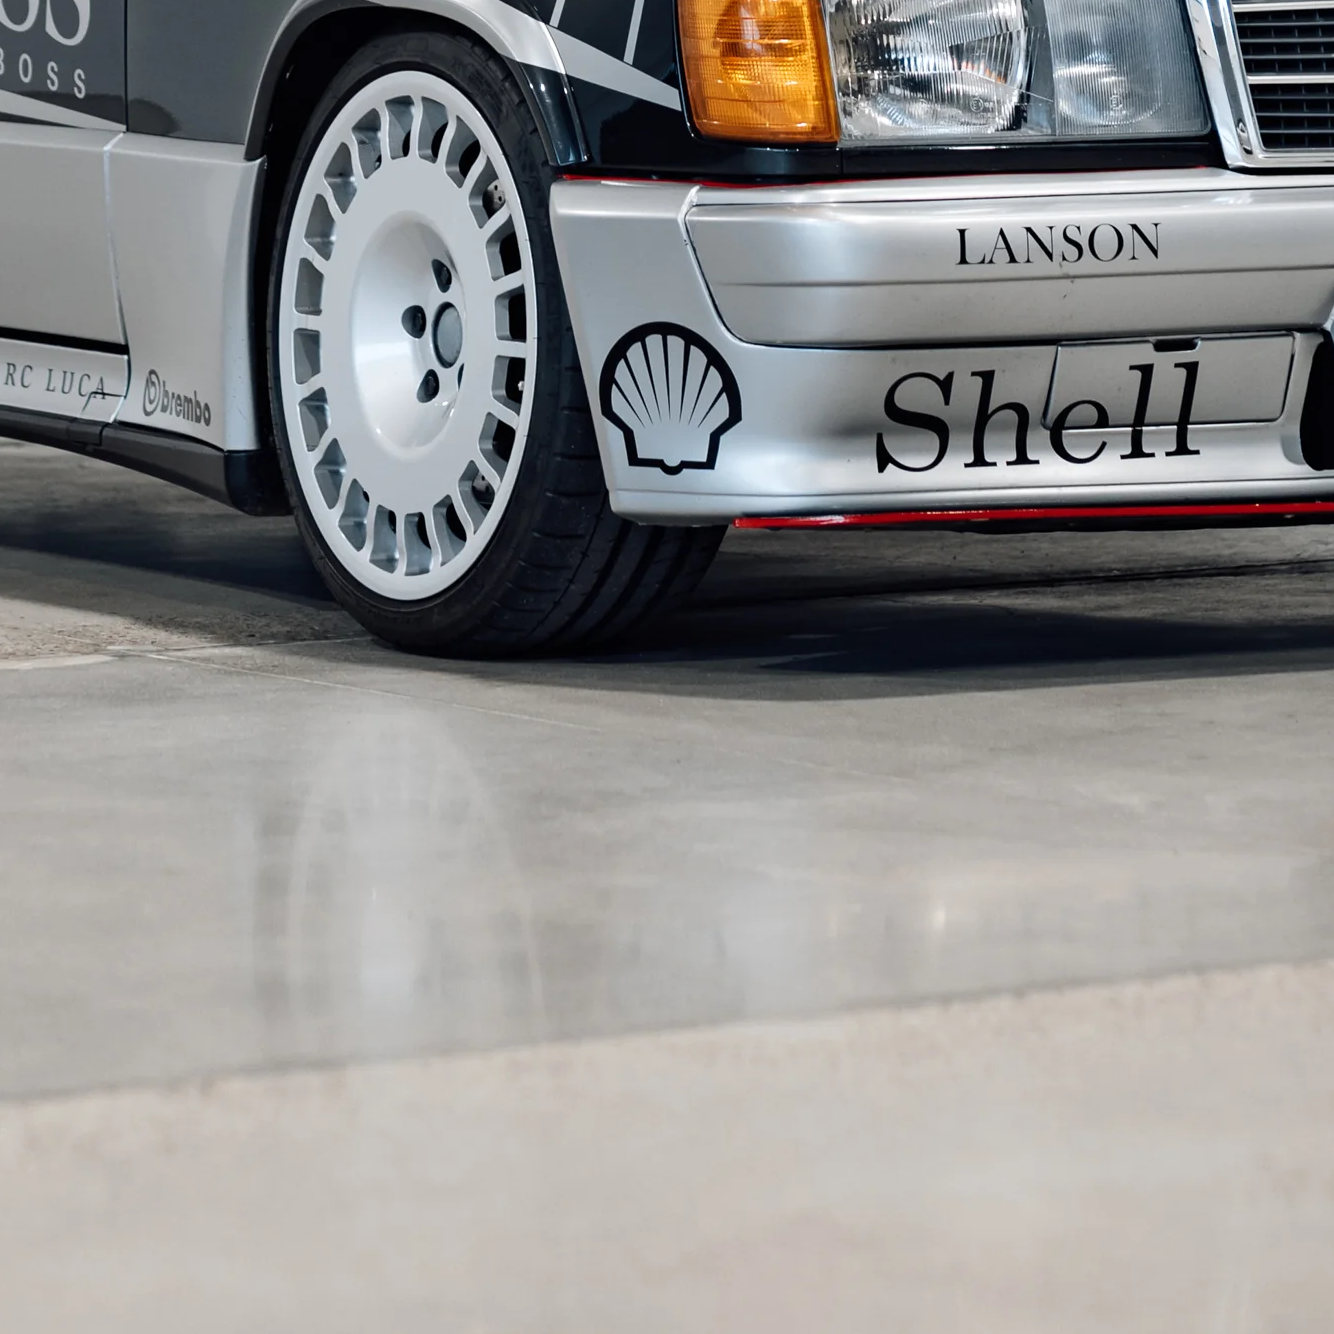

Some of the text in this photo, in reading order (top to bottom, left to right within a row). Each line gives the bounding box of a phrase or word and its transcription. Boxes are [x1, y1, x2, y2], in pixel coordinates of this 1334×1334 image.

[956, 222, 1162, 266] LANSON
[46, 368, 107, 400] LUCA
[159, 379, 213, 428] brembo
[875, 360, 1201, 473] Shell
